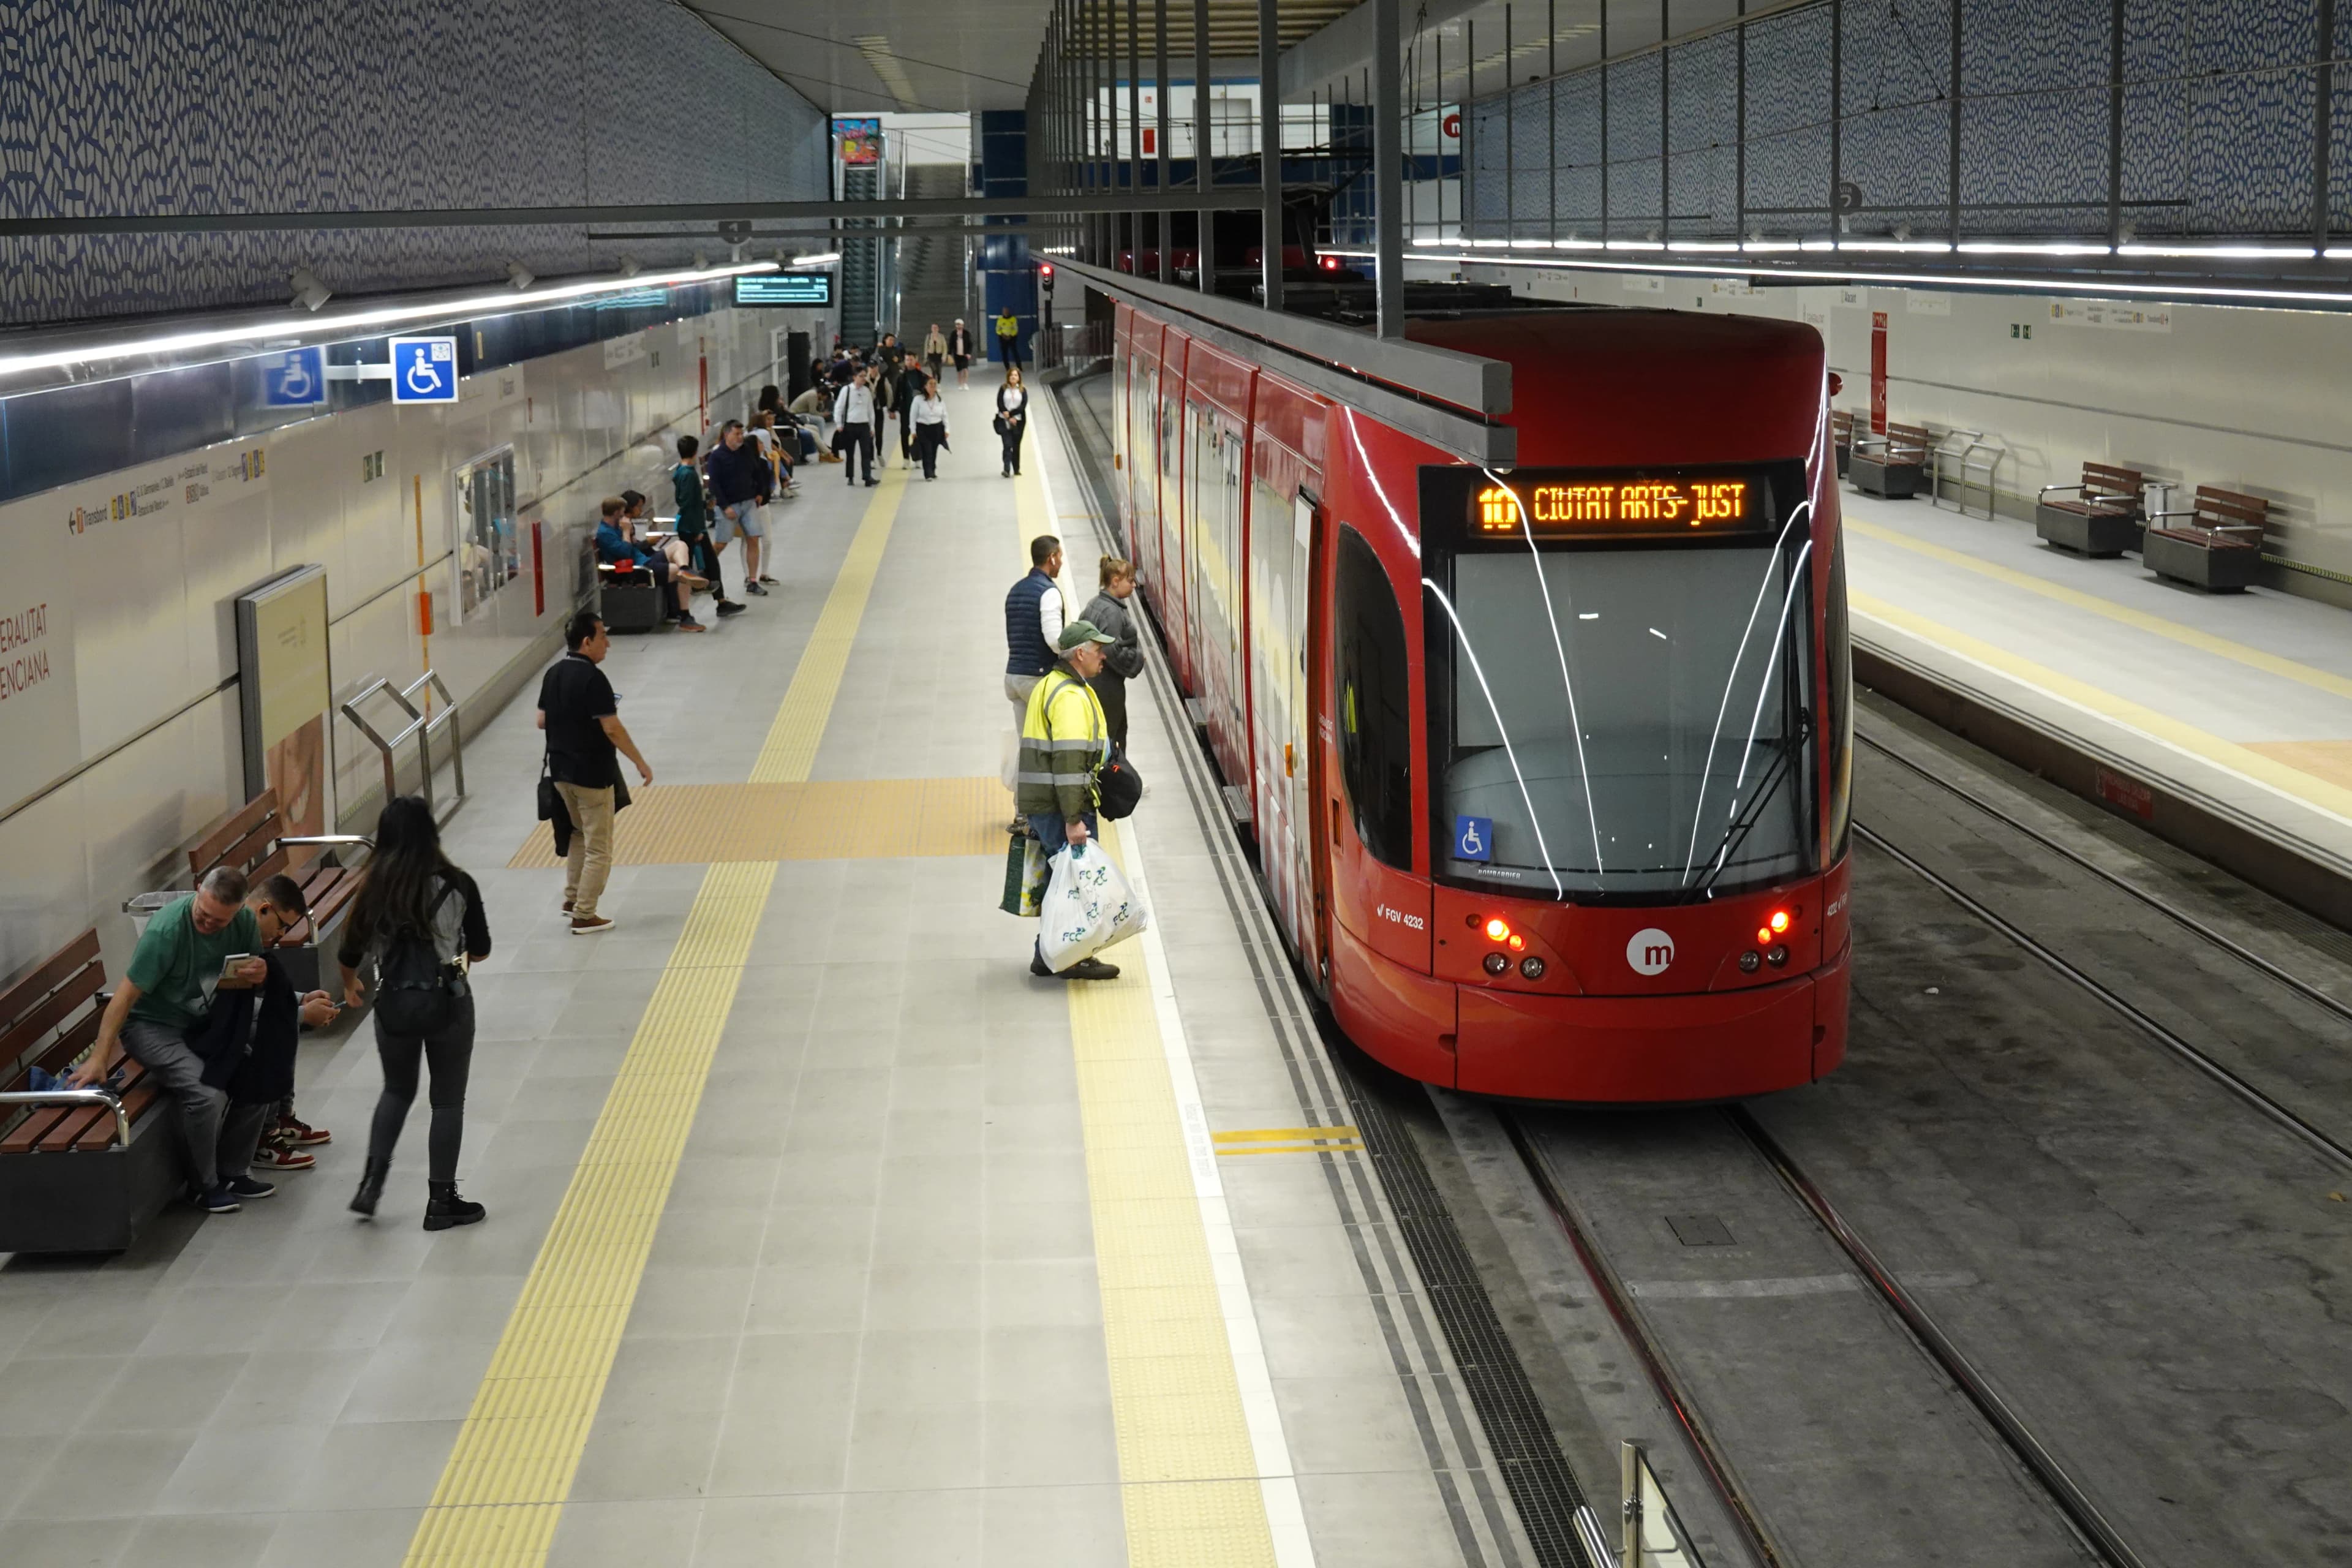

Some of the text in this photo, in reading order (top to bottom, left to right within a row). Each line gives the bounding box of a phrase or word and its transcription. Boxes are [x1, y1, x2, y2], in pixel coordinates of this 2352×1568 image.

[729, 222, 738, 241] 1
[83, 505, 108, 527] Transbord
[1479, 488, 1517, 529] 10
[1535, 486, 1614, 520] CIUTAT
[1478, 869, 1521, 880] BOMBARDIER
[1385, 908, 1424, 930] FGV 4232
[1062, 932, 1082, 941] FCC
[1645, 946, 1672, 965] m
